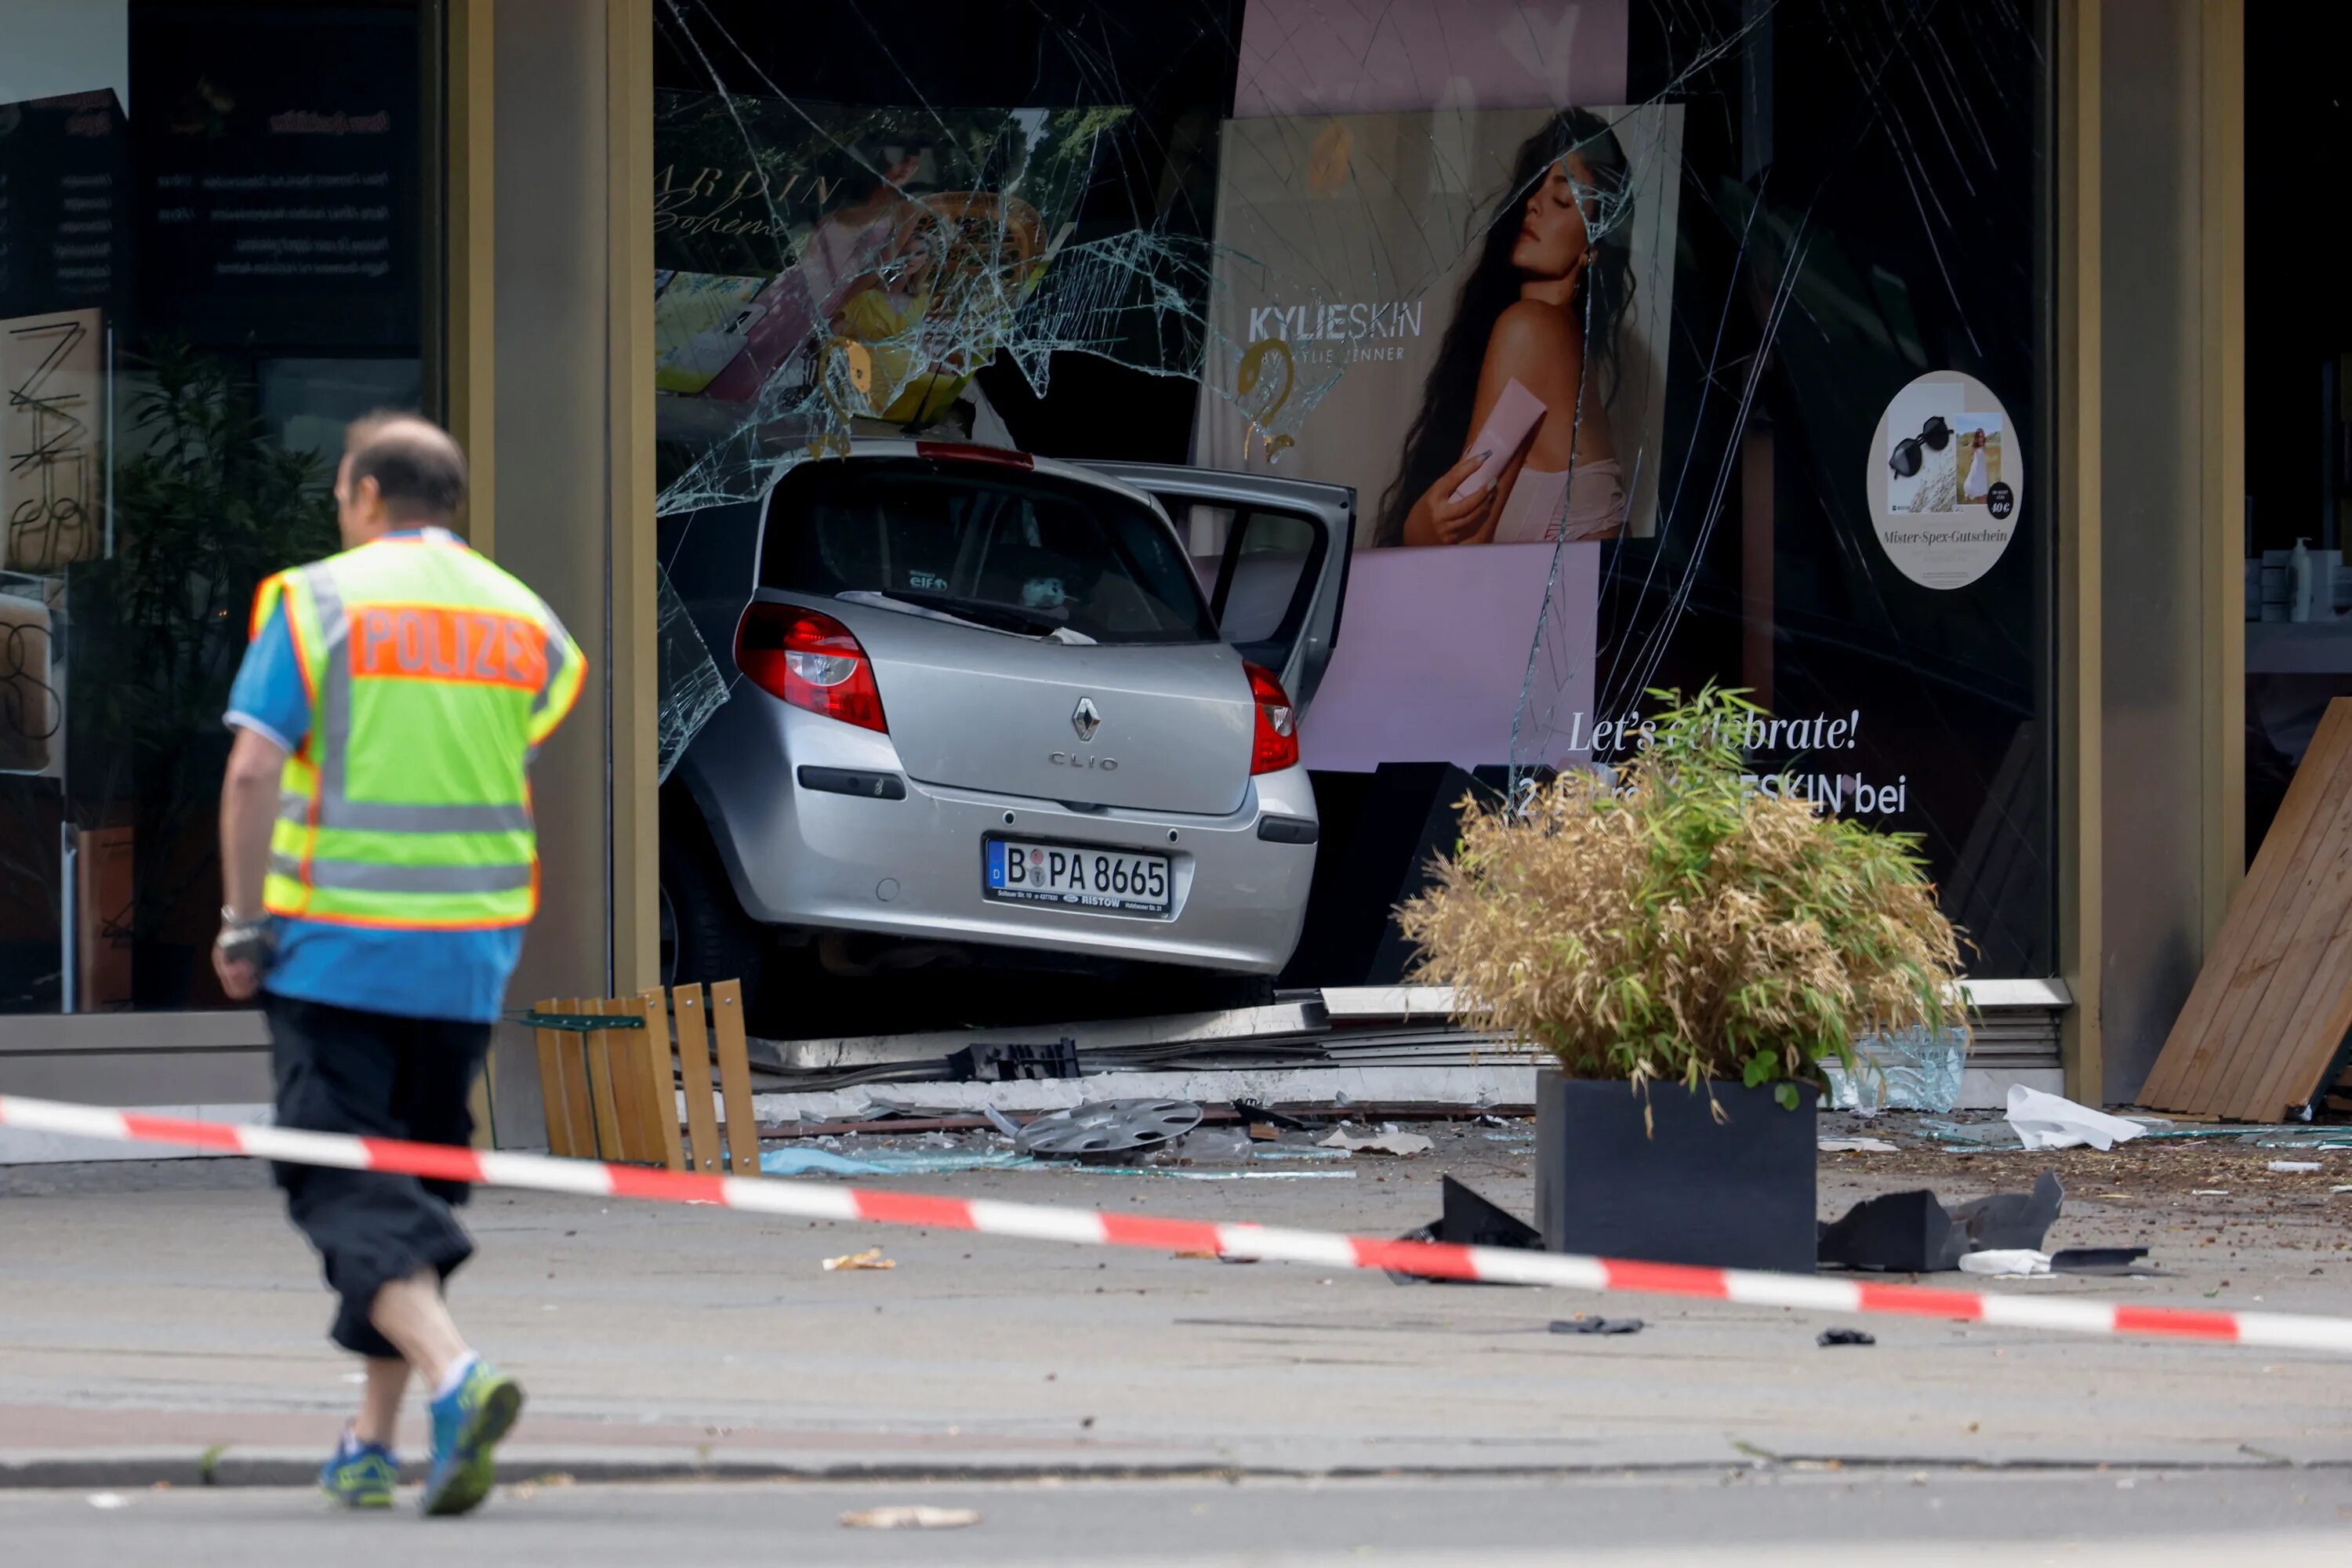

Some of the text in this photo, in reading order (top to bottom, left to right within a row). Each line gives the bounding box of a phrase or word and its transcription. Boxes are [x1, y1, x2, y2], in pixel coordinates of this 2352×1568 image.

[1248, 302, 1422, 343] KYLIESKIN
[1883, 529, 2008, 546] Mister-Spex-Gutschein
[365, 611, 526, 680] POLIZE
[1568, 711, 1657, 751] Let's
[1047, 750, 1118, 771] CLIO
[1855, 771, 1906, 814] bei
[993, 869, 1000, 880] D
[1008, 848, 1165, 897] B PA 8665
[1080, 895, 1120, 908] RISTOW
